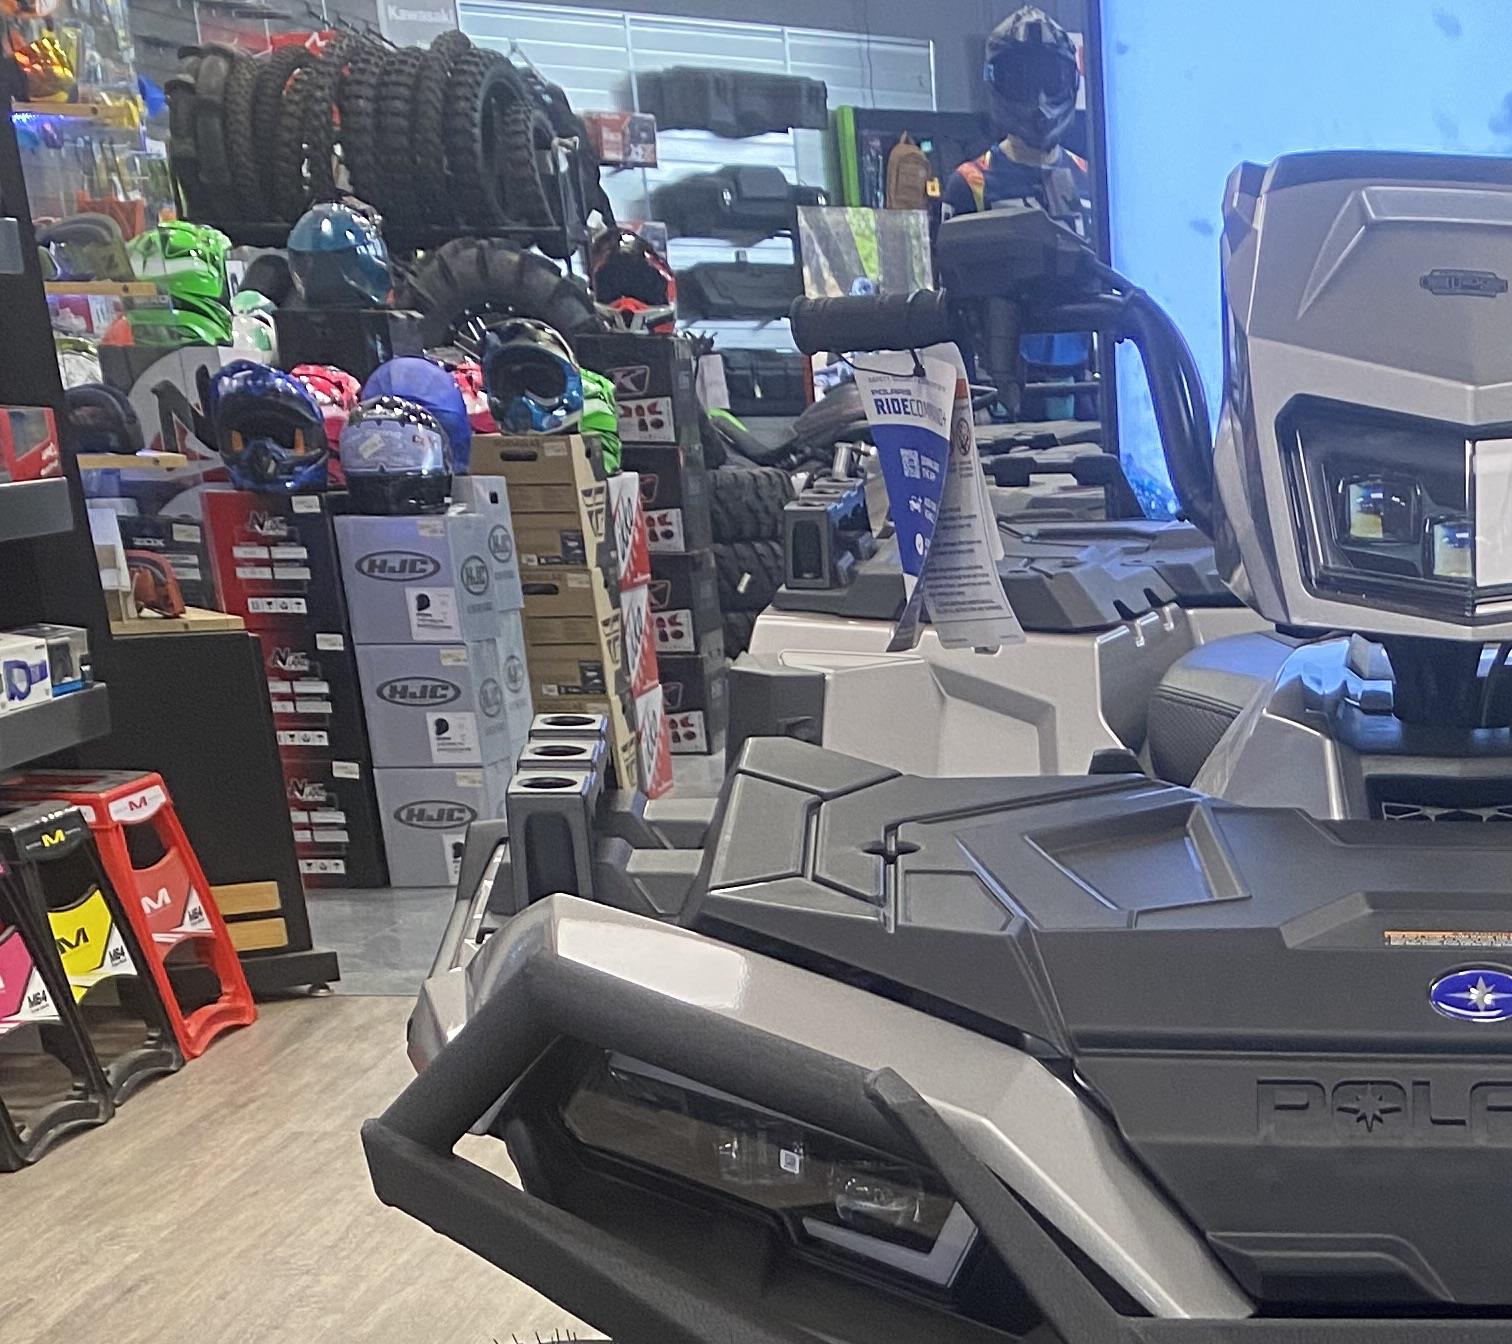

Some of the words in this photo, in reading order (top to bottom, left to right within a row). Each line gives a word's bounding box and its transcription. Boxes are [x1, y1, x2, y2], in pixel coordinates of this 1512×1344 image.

[871, 388, 912, 396] POLARIS
[367, 558, 429, 574] HJC
[388, 684, 450, 700] HJC
[405, 807, 466, 823] HJC
